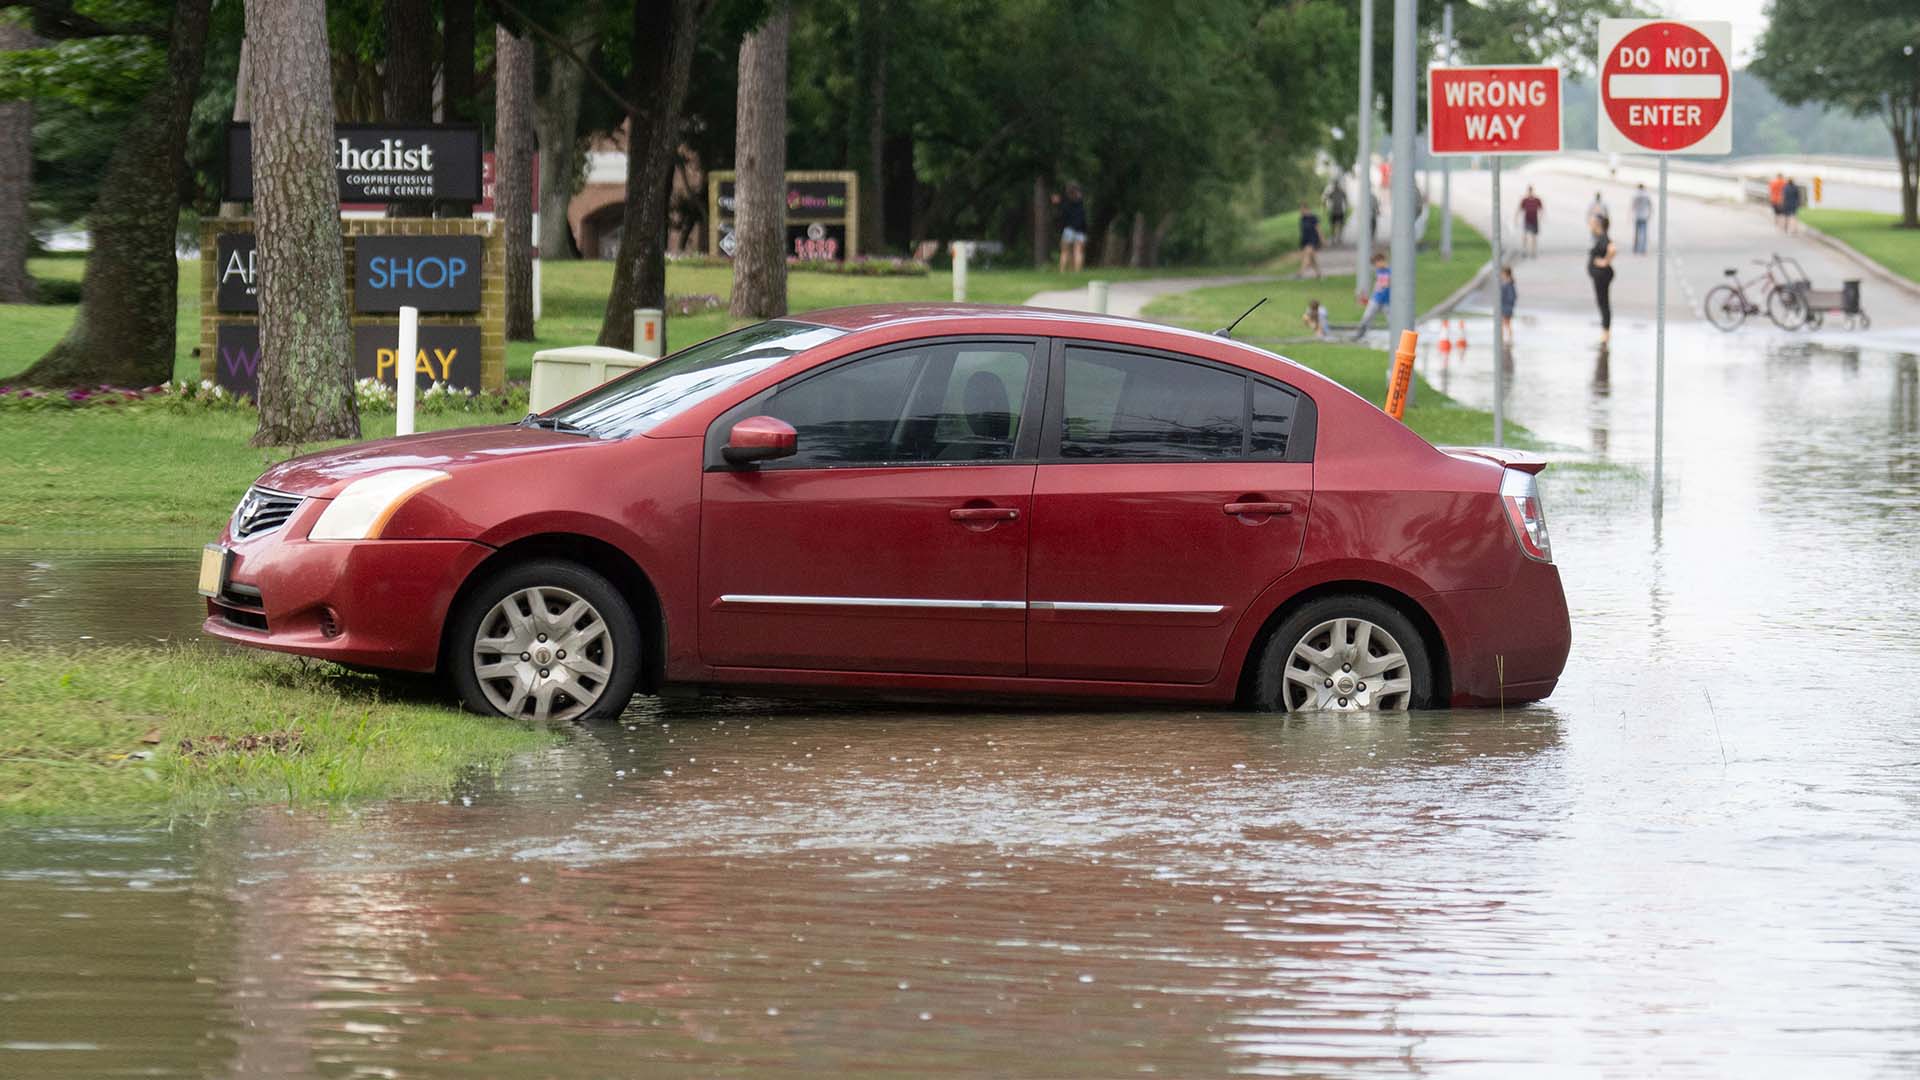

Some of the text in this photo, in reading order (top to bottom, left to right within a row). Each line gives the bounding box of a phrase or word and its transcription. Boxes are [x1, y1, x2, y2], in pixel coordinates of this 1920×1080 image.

[1619, 47, 1711, 68] DO NOT
[1444, 80, 1546, 107] WRONG
[1465, 114, 1526, 140] WAY
[1629, 105, 1702, 126] ENTER
[335, 138, 433, 171] hodist
[346, 175, 433, 185] COMPREHENSIVE
[363, 186, 433, 196] CARE CENTER
[368, 256, 467, 289] SHOP
